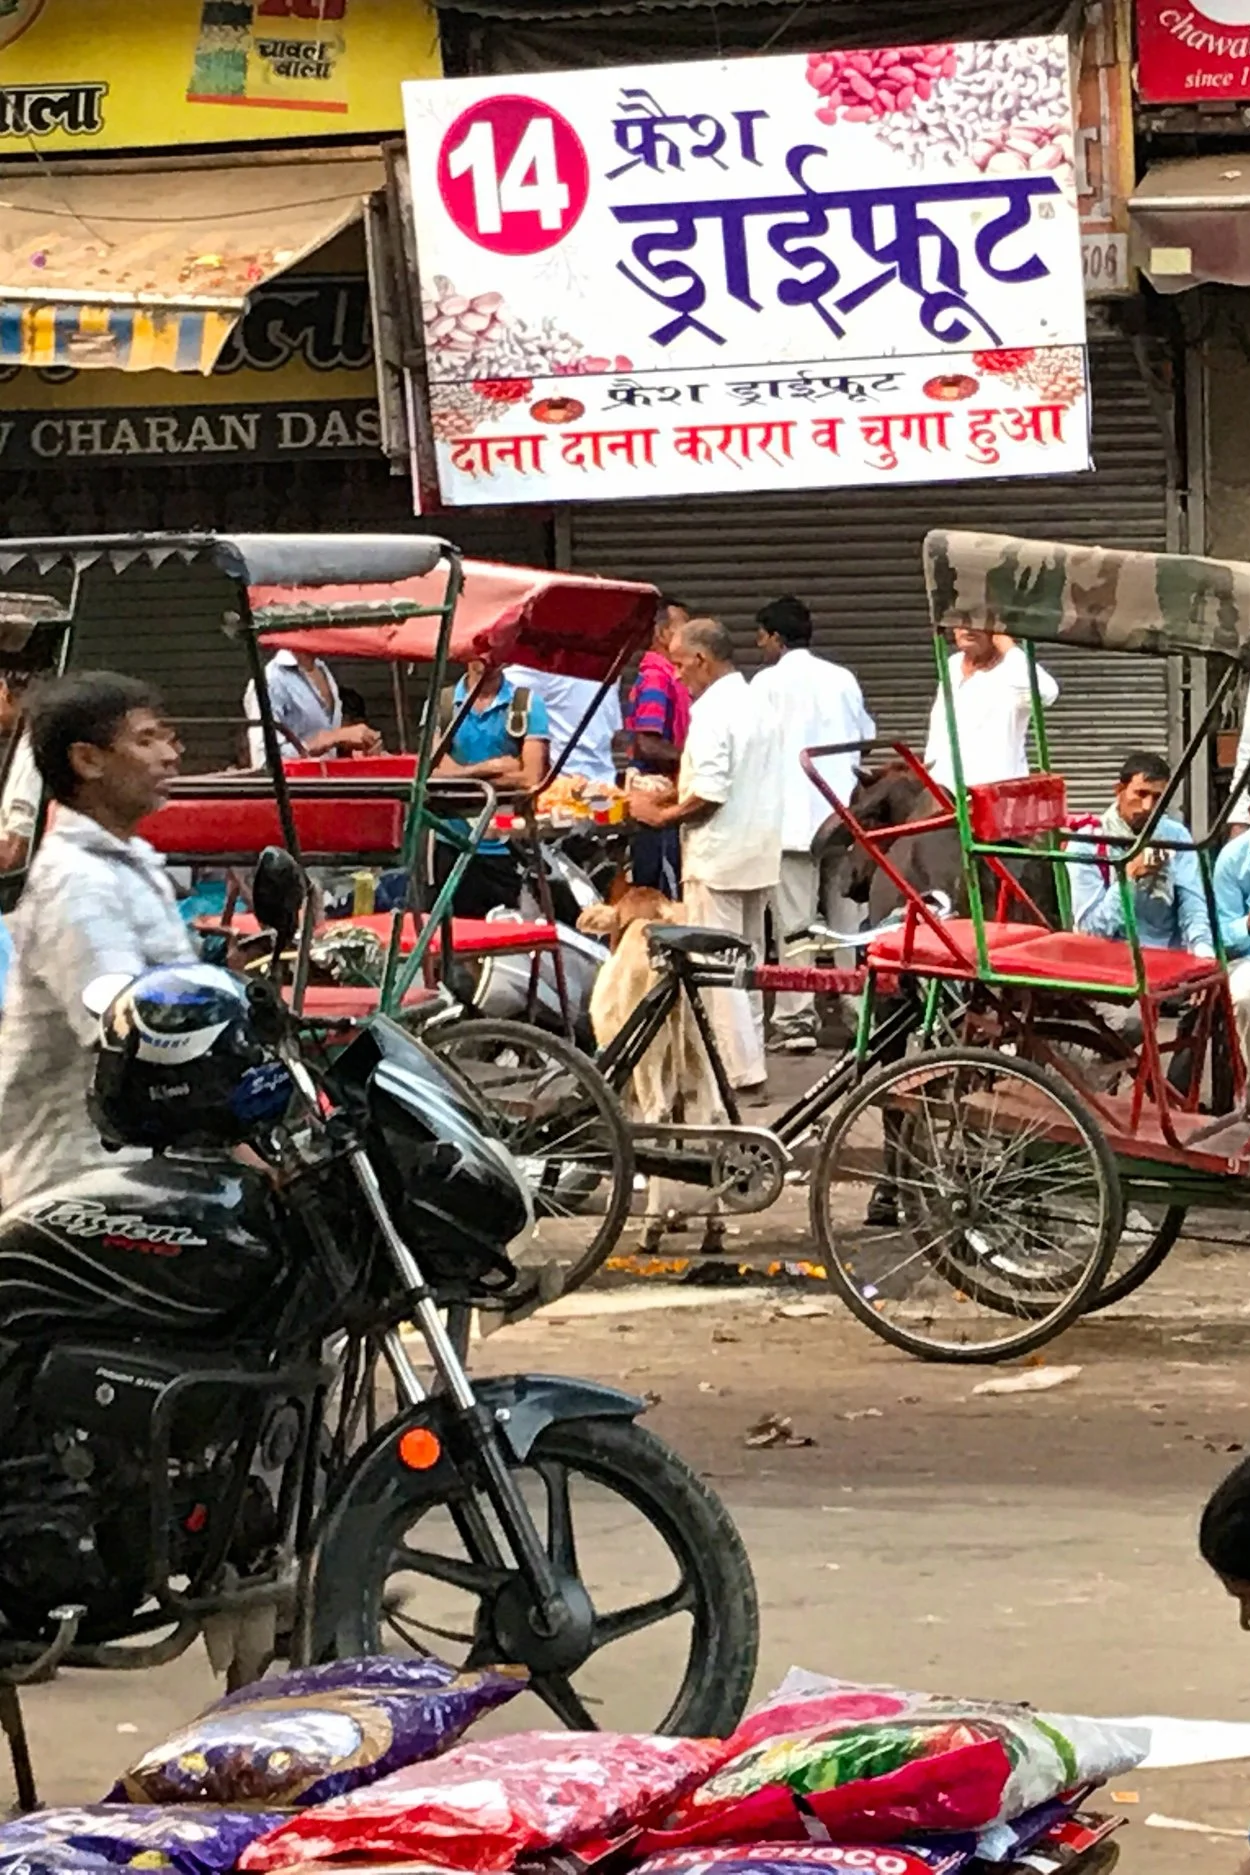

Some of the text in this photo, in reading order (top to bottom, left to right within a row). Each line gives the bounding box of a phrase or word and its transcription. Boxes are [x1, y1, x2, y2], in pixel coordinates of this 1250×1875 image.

[1184, 69, 1234, 88] since
[605, 88, 770, 180] फ्रैश
[448, 117, 570, 235] 14
[608, 144, 1061, 347] ड्राईफ्रूट
[601, 370, 905, 411] फ्रैश ड्राईफ्रूट
[30, 411, 261, 458] CHARAN
[277, 408, 383, 451] DAS
[450, 403, 1070, 480] दाना दाना करारा व चुगा हुआ
[749, 1847, 909, 1874] CHOCO
